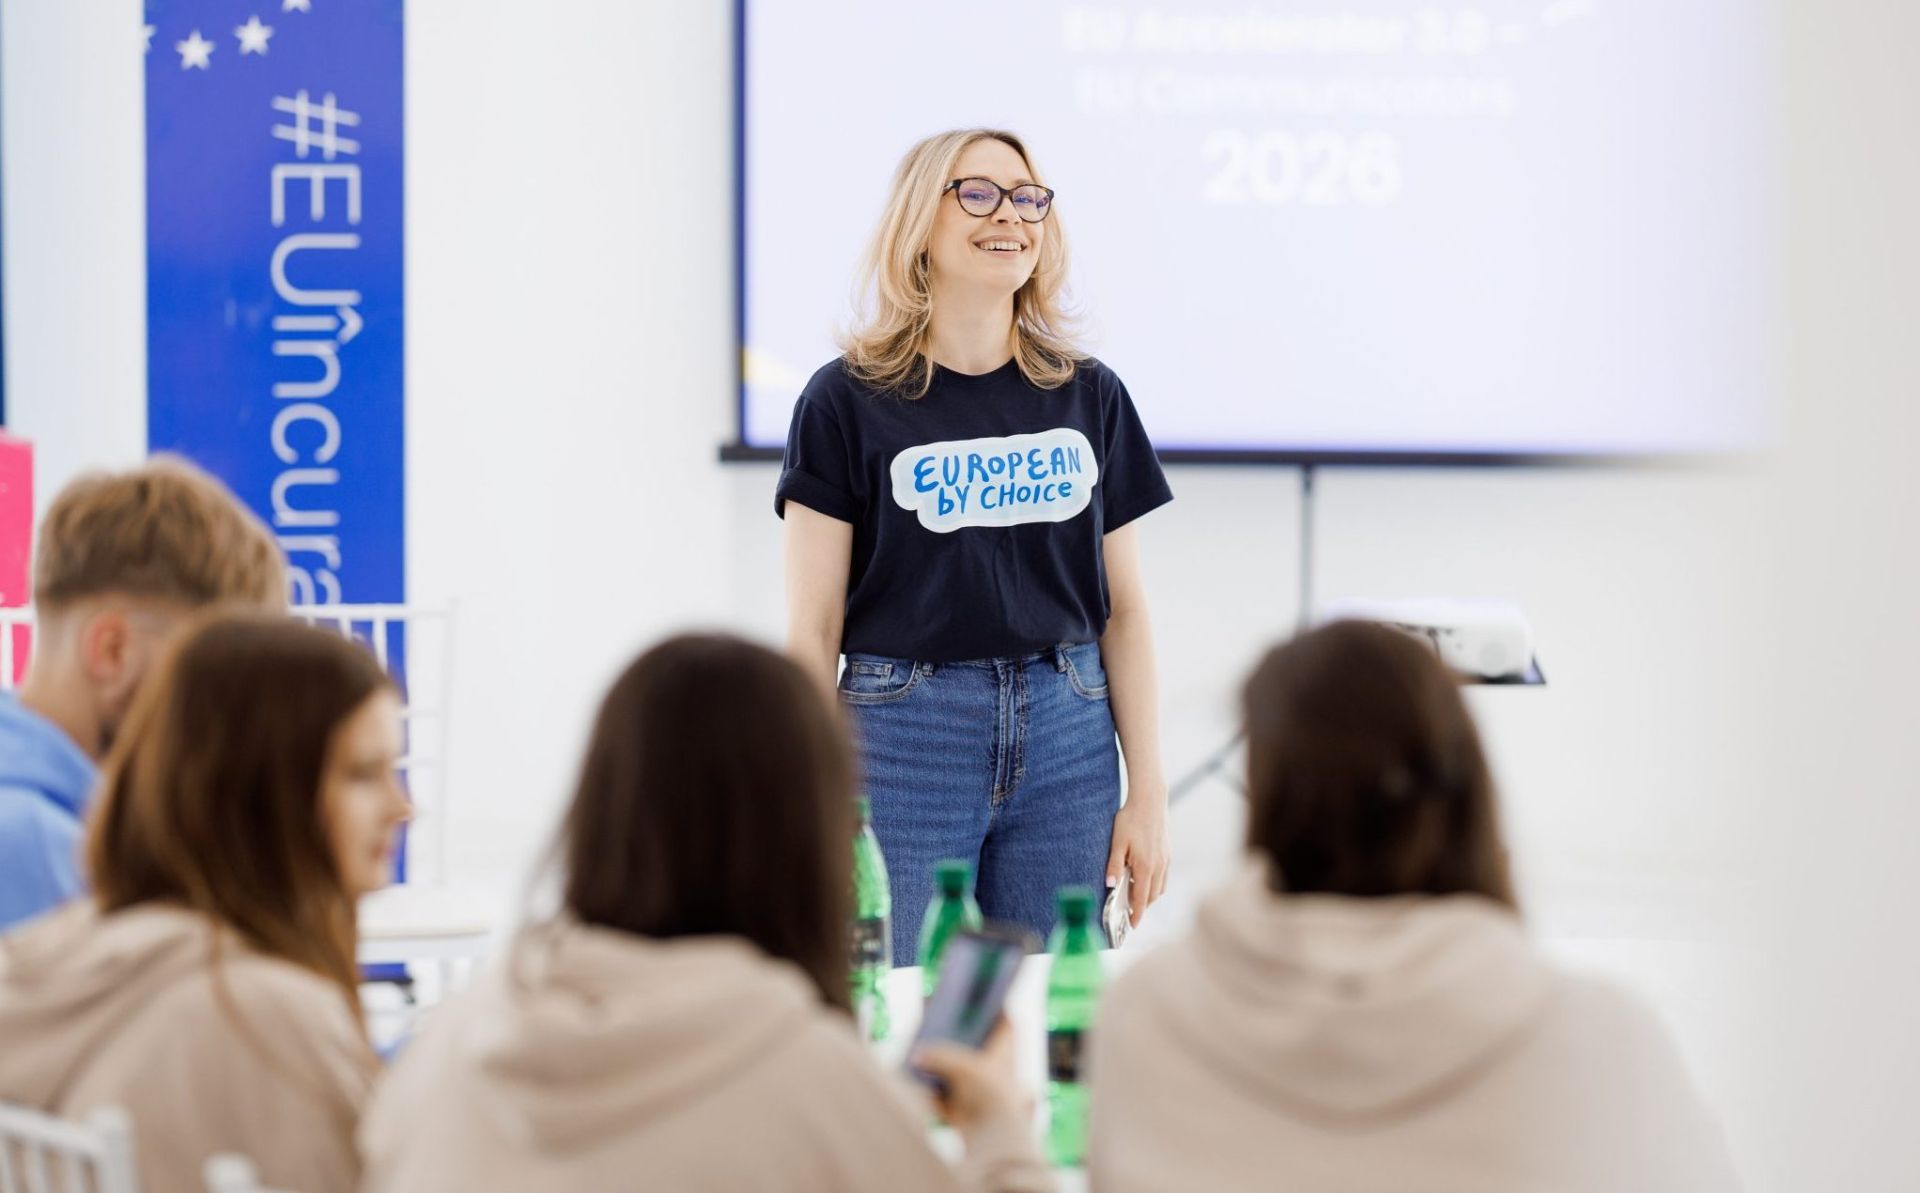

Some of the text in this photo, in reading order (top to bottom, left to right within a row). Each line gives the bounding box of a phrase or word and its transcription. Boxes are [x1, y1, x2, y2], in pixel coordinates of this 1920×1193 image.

[1202, 130, 1402, 206] 2026
[270, 89, 363, 606] #EUîncura
[913, 447, 1082, 493] EUROPEAN
